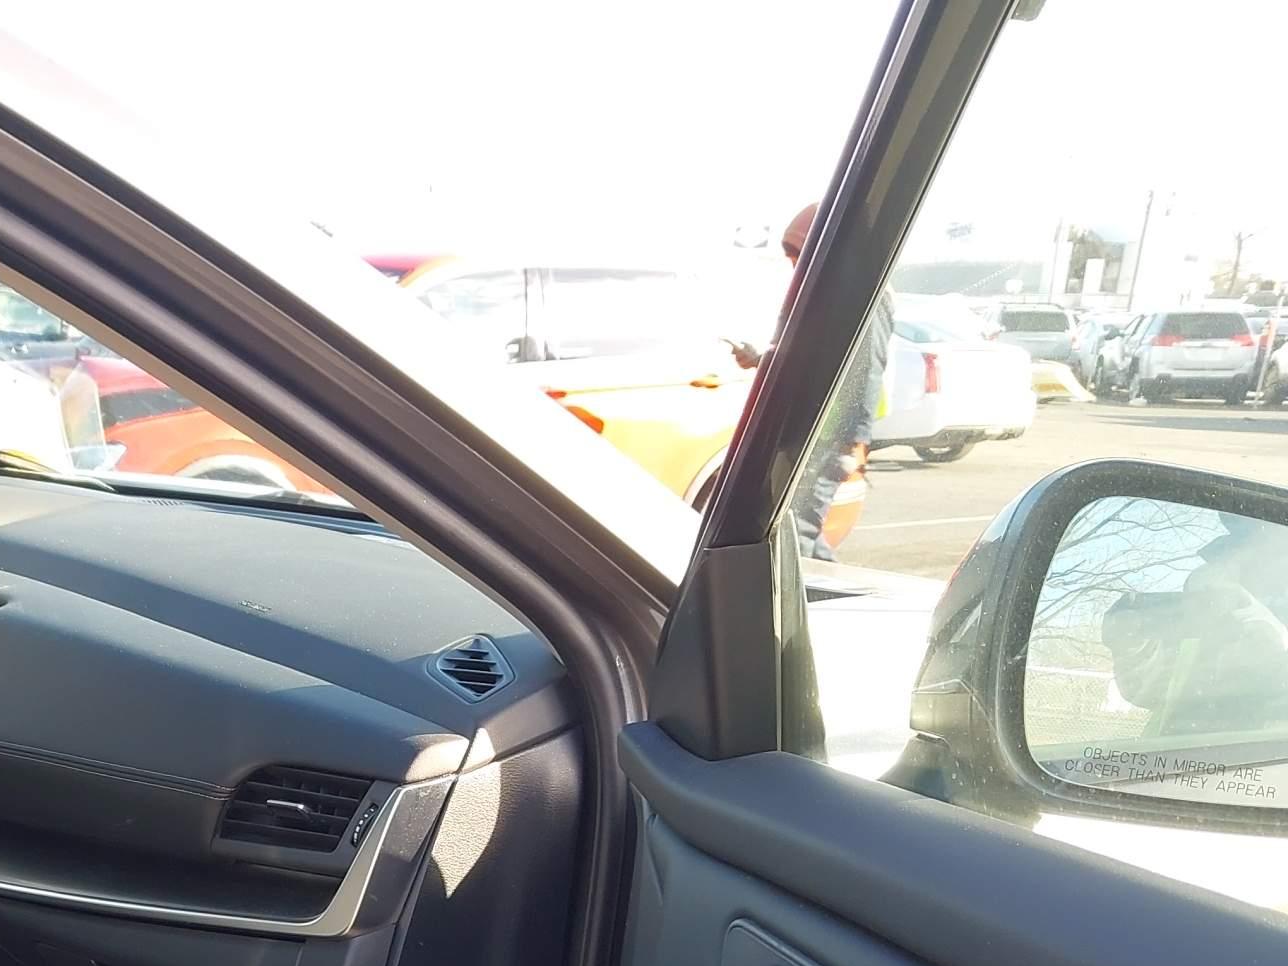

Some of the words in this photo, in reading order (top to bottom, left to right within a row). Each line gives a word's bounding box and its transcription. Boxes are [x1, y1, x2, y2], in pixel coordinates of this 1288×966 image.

[1064, 759, 1120, 777] CLOSER
[1128, 767, 1165, 783] THAN
[1174, 773, 1208, 789] THEY
[1215, 780, 1277, 799] APPEAR
[1083, 746, 1148, 766] OBJECTS
[1154, 756, 1167, 769] IN
[1173, 758, 1226, 776] MIRROR
[1233, 767, 1263, 782] ARE
